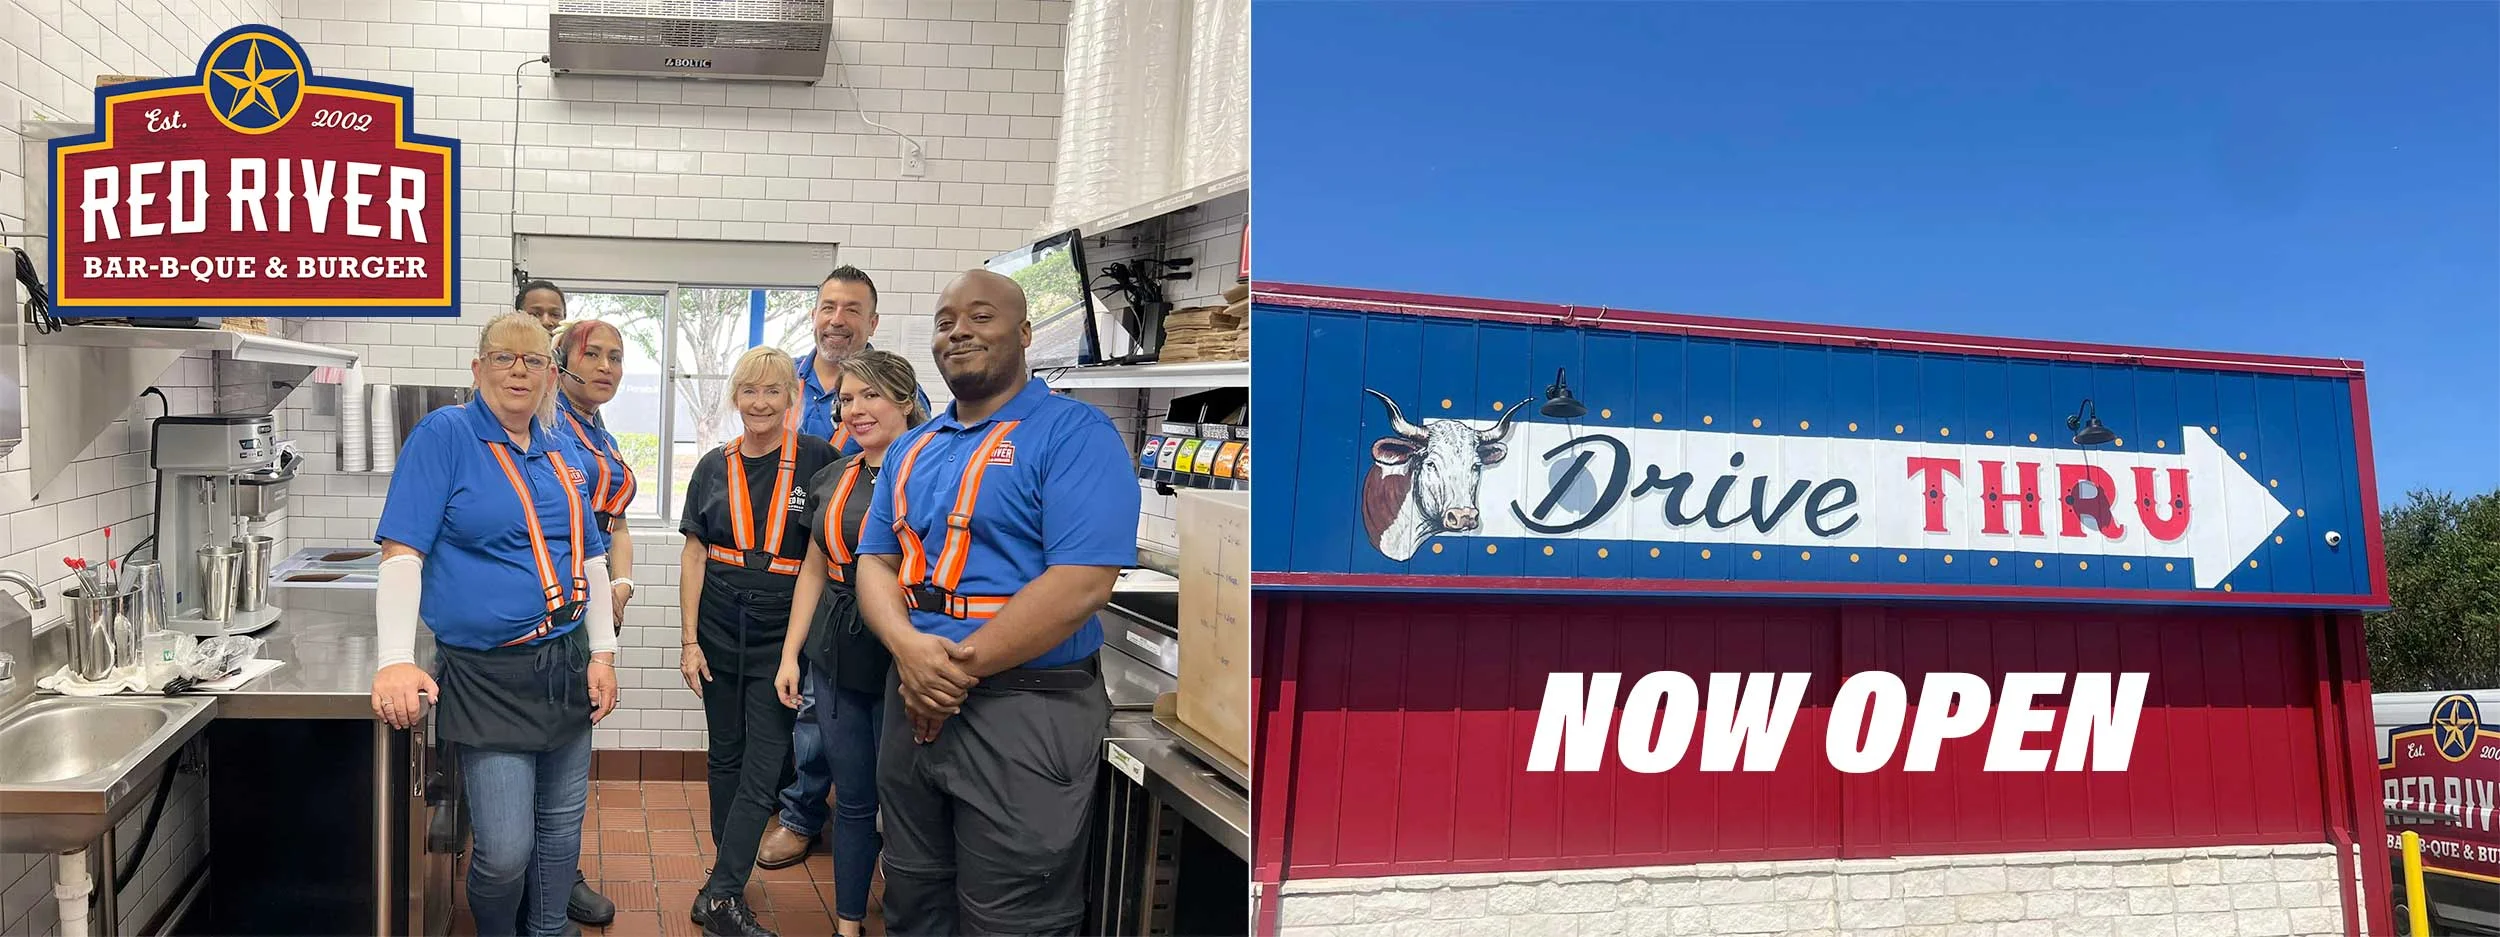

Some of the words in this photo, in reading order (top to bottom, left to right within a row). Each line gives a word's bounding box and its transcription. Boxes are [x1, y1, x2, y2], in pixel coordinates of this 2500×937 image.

[675, 58, 710, 68] BOLTIC
[991, 447, 1012, 458] IVER
[1510, 433, 1859, 537] Drive
[1906, 456, 2191, 541] THRU
[2407, 743, 2426, 759] Est.
[2383, 776, 2437, 826] RED
[2444, 776, 2500, 832] RIV
[2463, 844, 2474, 861] &
[2478, 846, 2500, 863] BU
